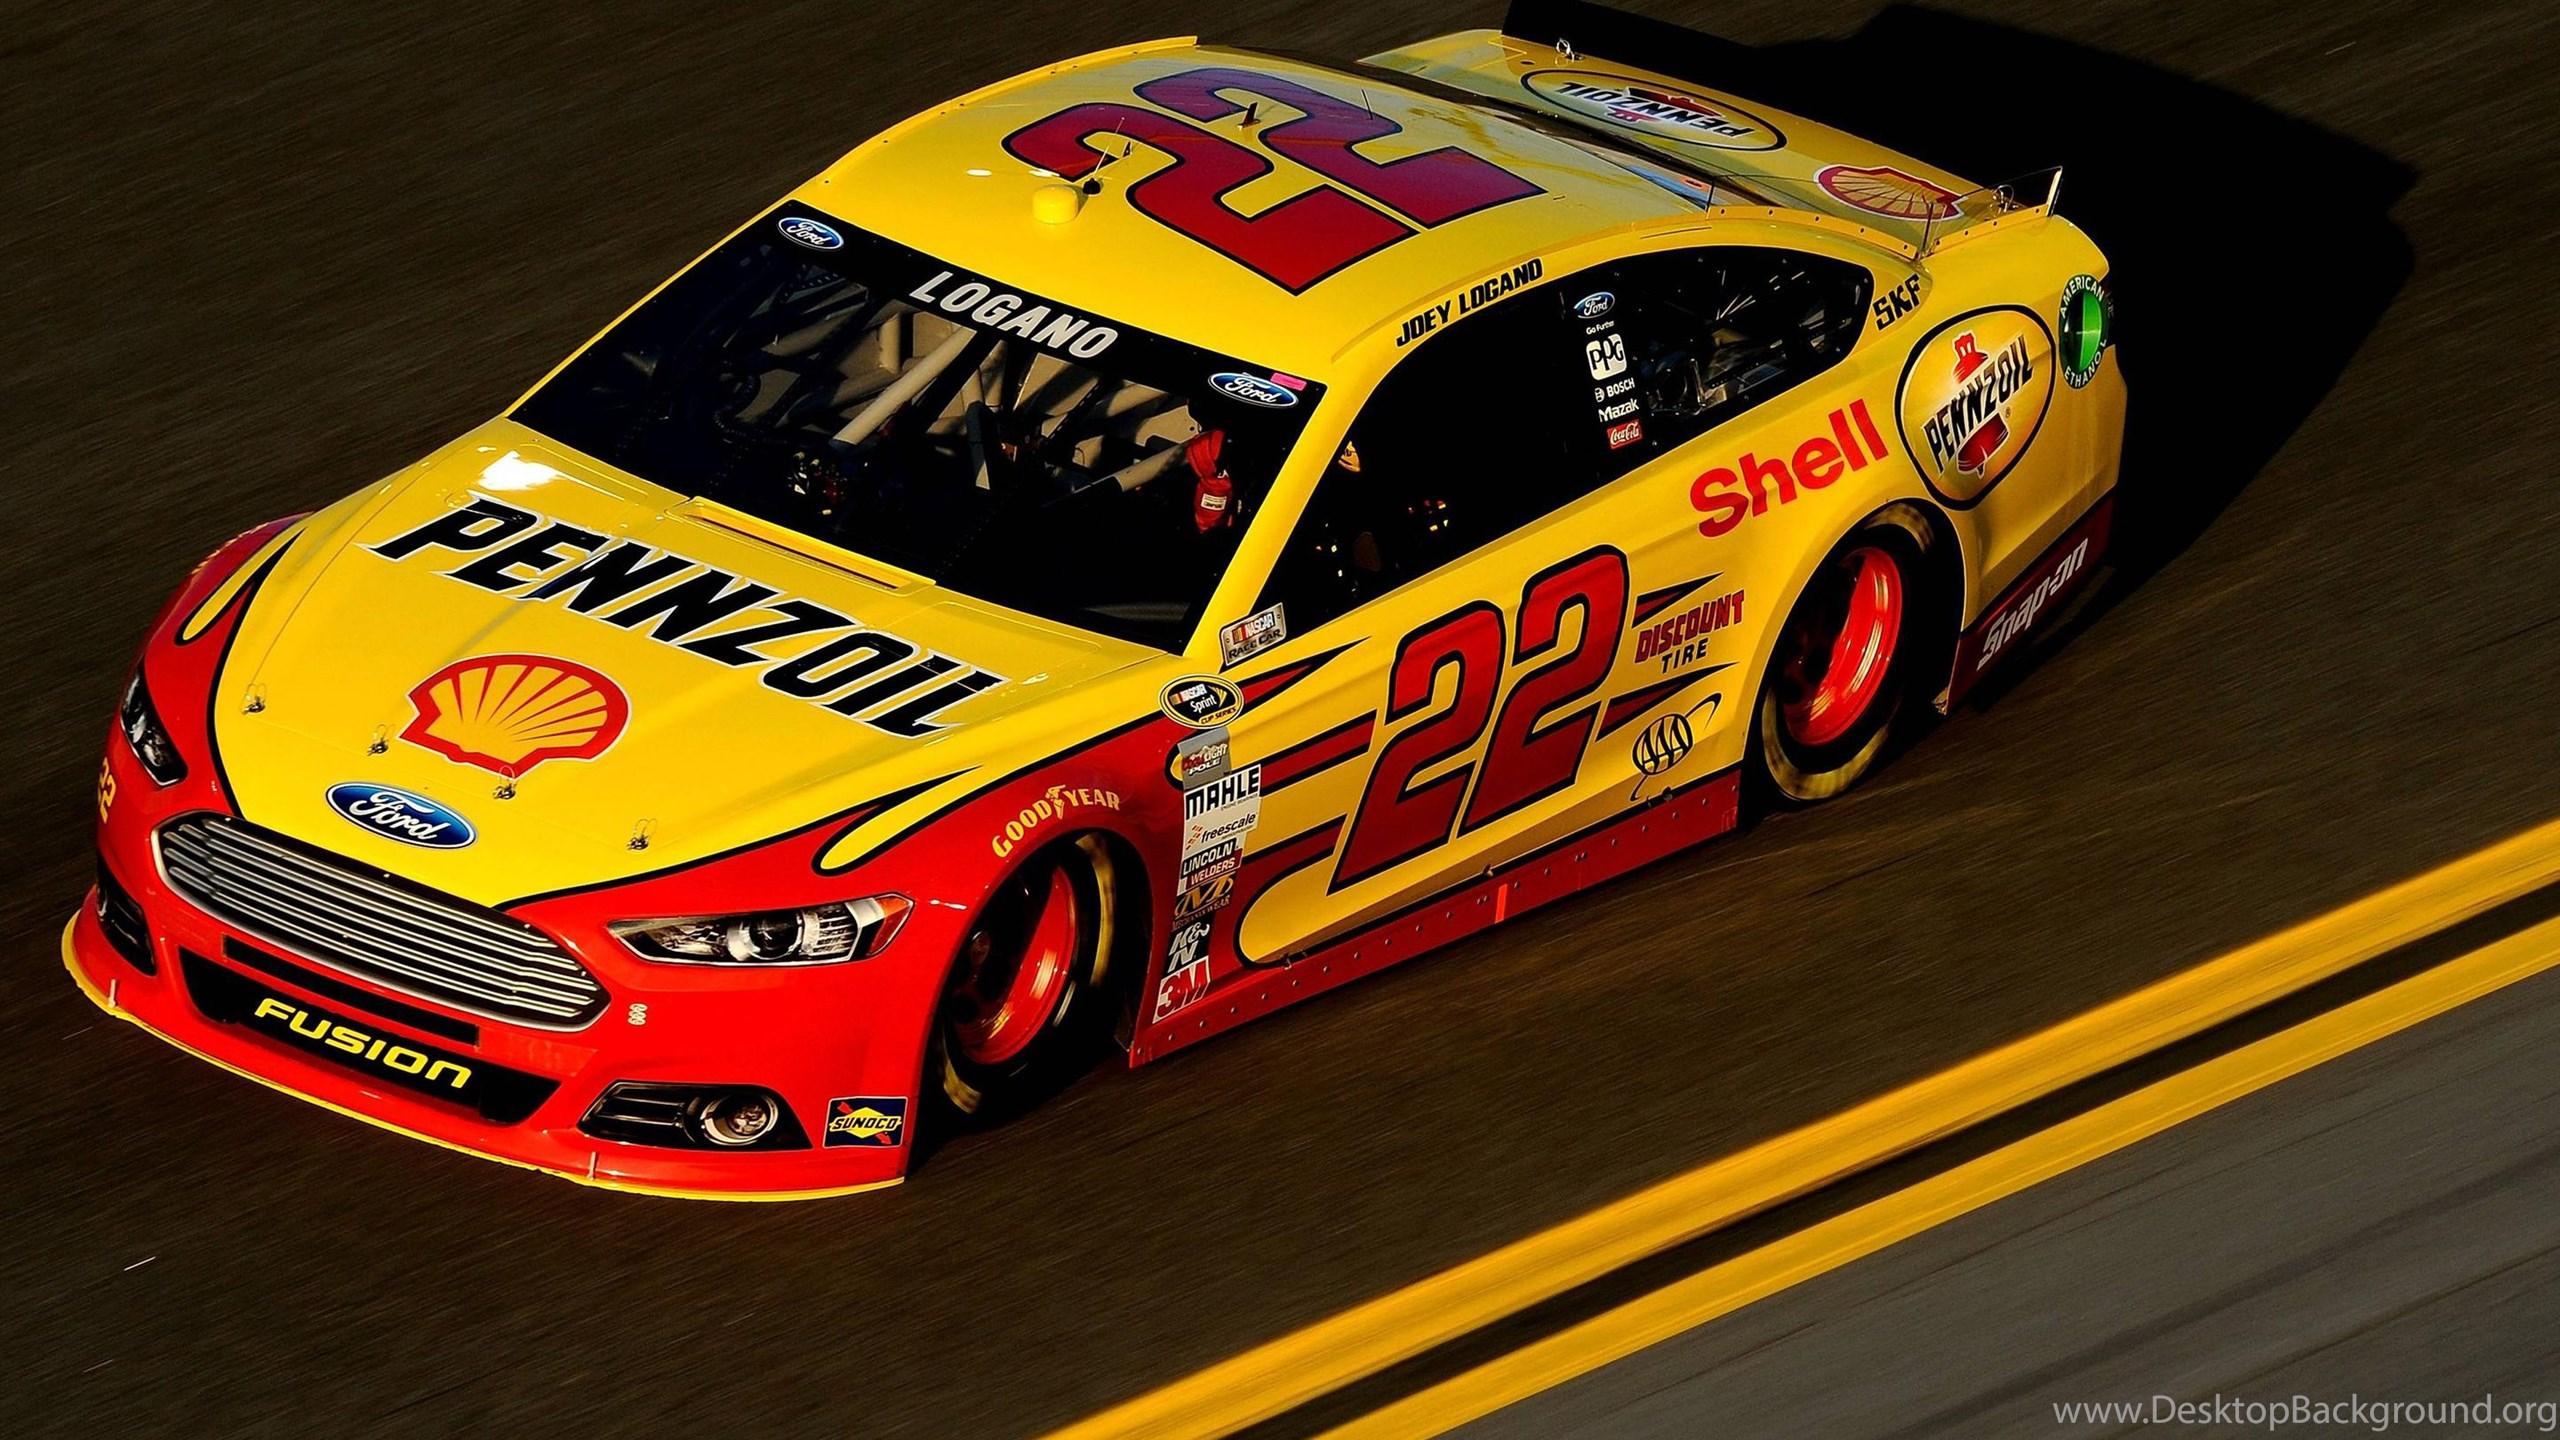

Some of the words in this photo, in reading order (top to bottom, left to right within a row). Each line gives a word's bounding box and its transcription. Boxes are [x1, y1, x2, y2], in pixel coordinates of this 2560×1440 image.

[1554, 82, 1755, 137] PENNZOIL
[1000, 67, 1549, 296] 22
[908, 271, 1119, 359] LOGANO
[1396, 299, 1451, 347] JOEY
[1458, 257, 1543, 315] LOGANO
[1873, 274, 1921, 331] SKF
[2060, 275, 2105, 320] AMERICAN
[1586, 326, 1596, 335] Go
[1589, 336, 1624, 371] PPG
[1606, 377, 1635, 398] BOSCH
[2063, 338, 2107, 388] ETHANOL
[1598, 398, 1640, 423] Mazak
[1921, 333, 2035, 475] PENNZOIL
[1689, 399, 1889, 538] Shell
[364, 491, 1010, 738] PENNZOIL
[1634, 590, 1745, 663] DISCOUNT
[1228, 641, 1257, 660] RACE
[1258, 628, 1283, 644] CAR
[1662, 637, 1709, 674] TIRE
[1190, 693, 1217, 713] Sprint
[1326, 544, 1630, 896] 22
[1188, 757, 1222, 776] POLE
[1637, 716, 1693, 768] AAA
[1186, 767, 1260, 820] MAHLE
[1201, 813, 1256, 843] freescale
[1183, 841, 1234, 876] LINCOLN
[1191, 857, 1236, 886] WELDERS
[1156, 961, 1209, 1019] 3M
[254, 998, 472, 1090] FUSION
[832, 1116, 898, 1130] SUNOCO
